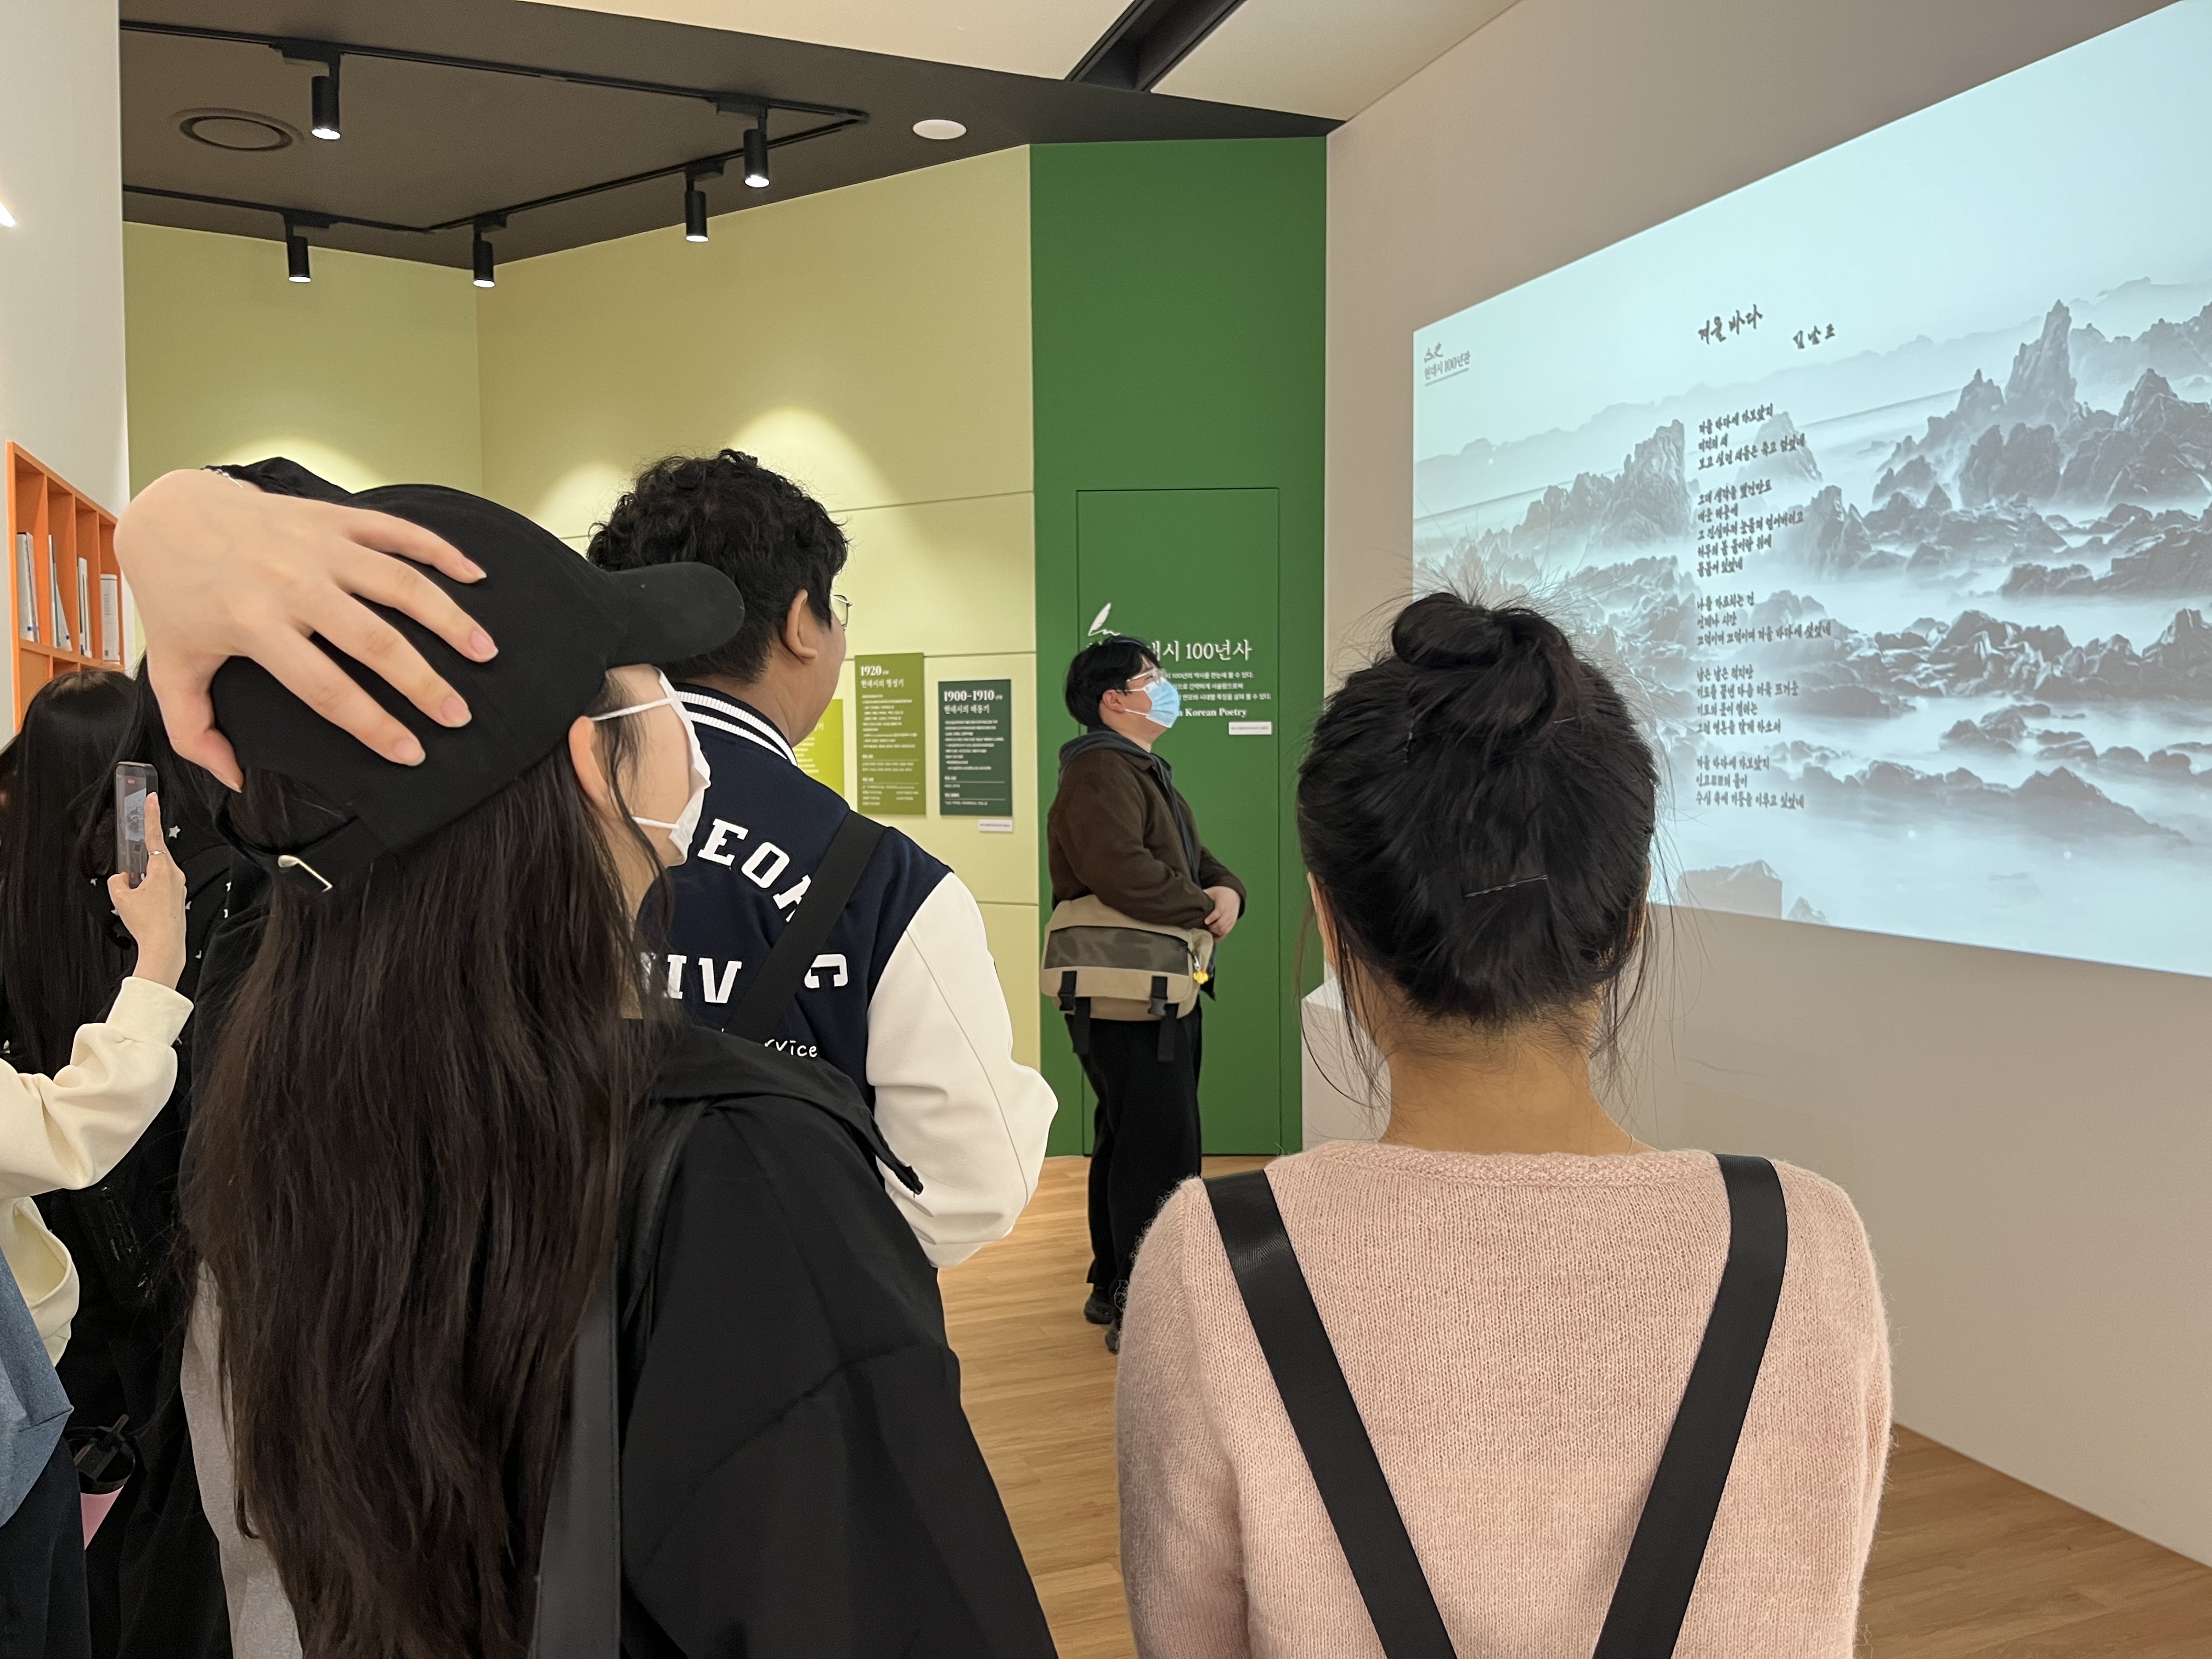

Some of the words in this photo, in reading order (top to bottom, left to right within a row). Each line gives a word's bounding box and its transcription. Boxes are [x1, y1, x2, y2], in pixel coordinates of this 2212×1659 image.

[1698, 316, 1726, 345] 겨울
[1728, 303, 1763, 335] 바다
[1792, 323, 1836, 349] 김남조
[1698, 456, 1714, 471] 보고
[1697, 530, 1705, 540] 그
[1186, 639, 1253, 661] 100년사
[1185, 708, 1216, 716] Korean
[1219, 708, 1246, 718] Poetry
